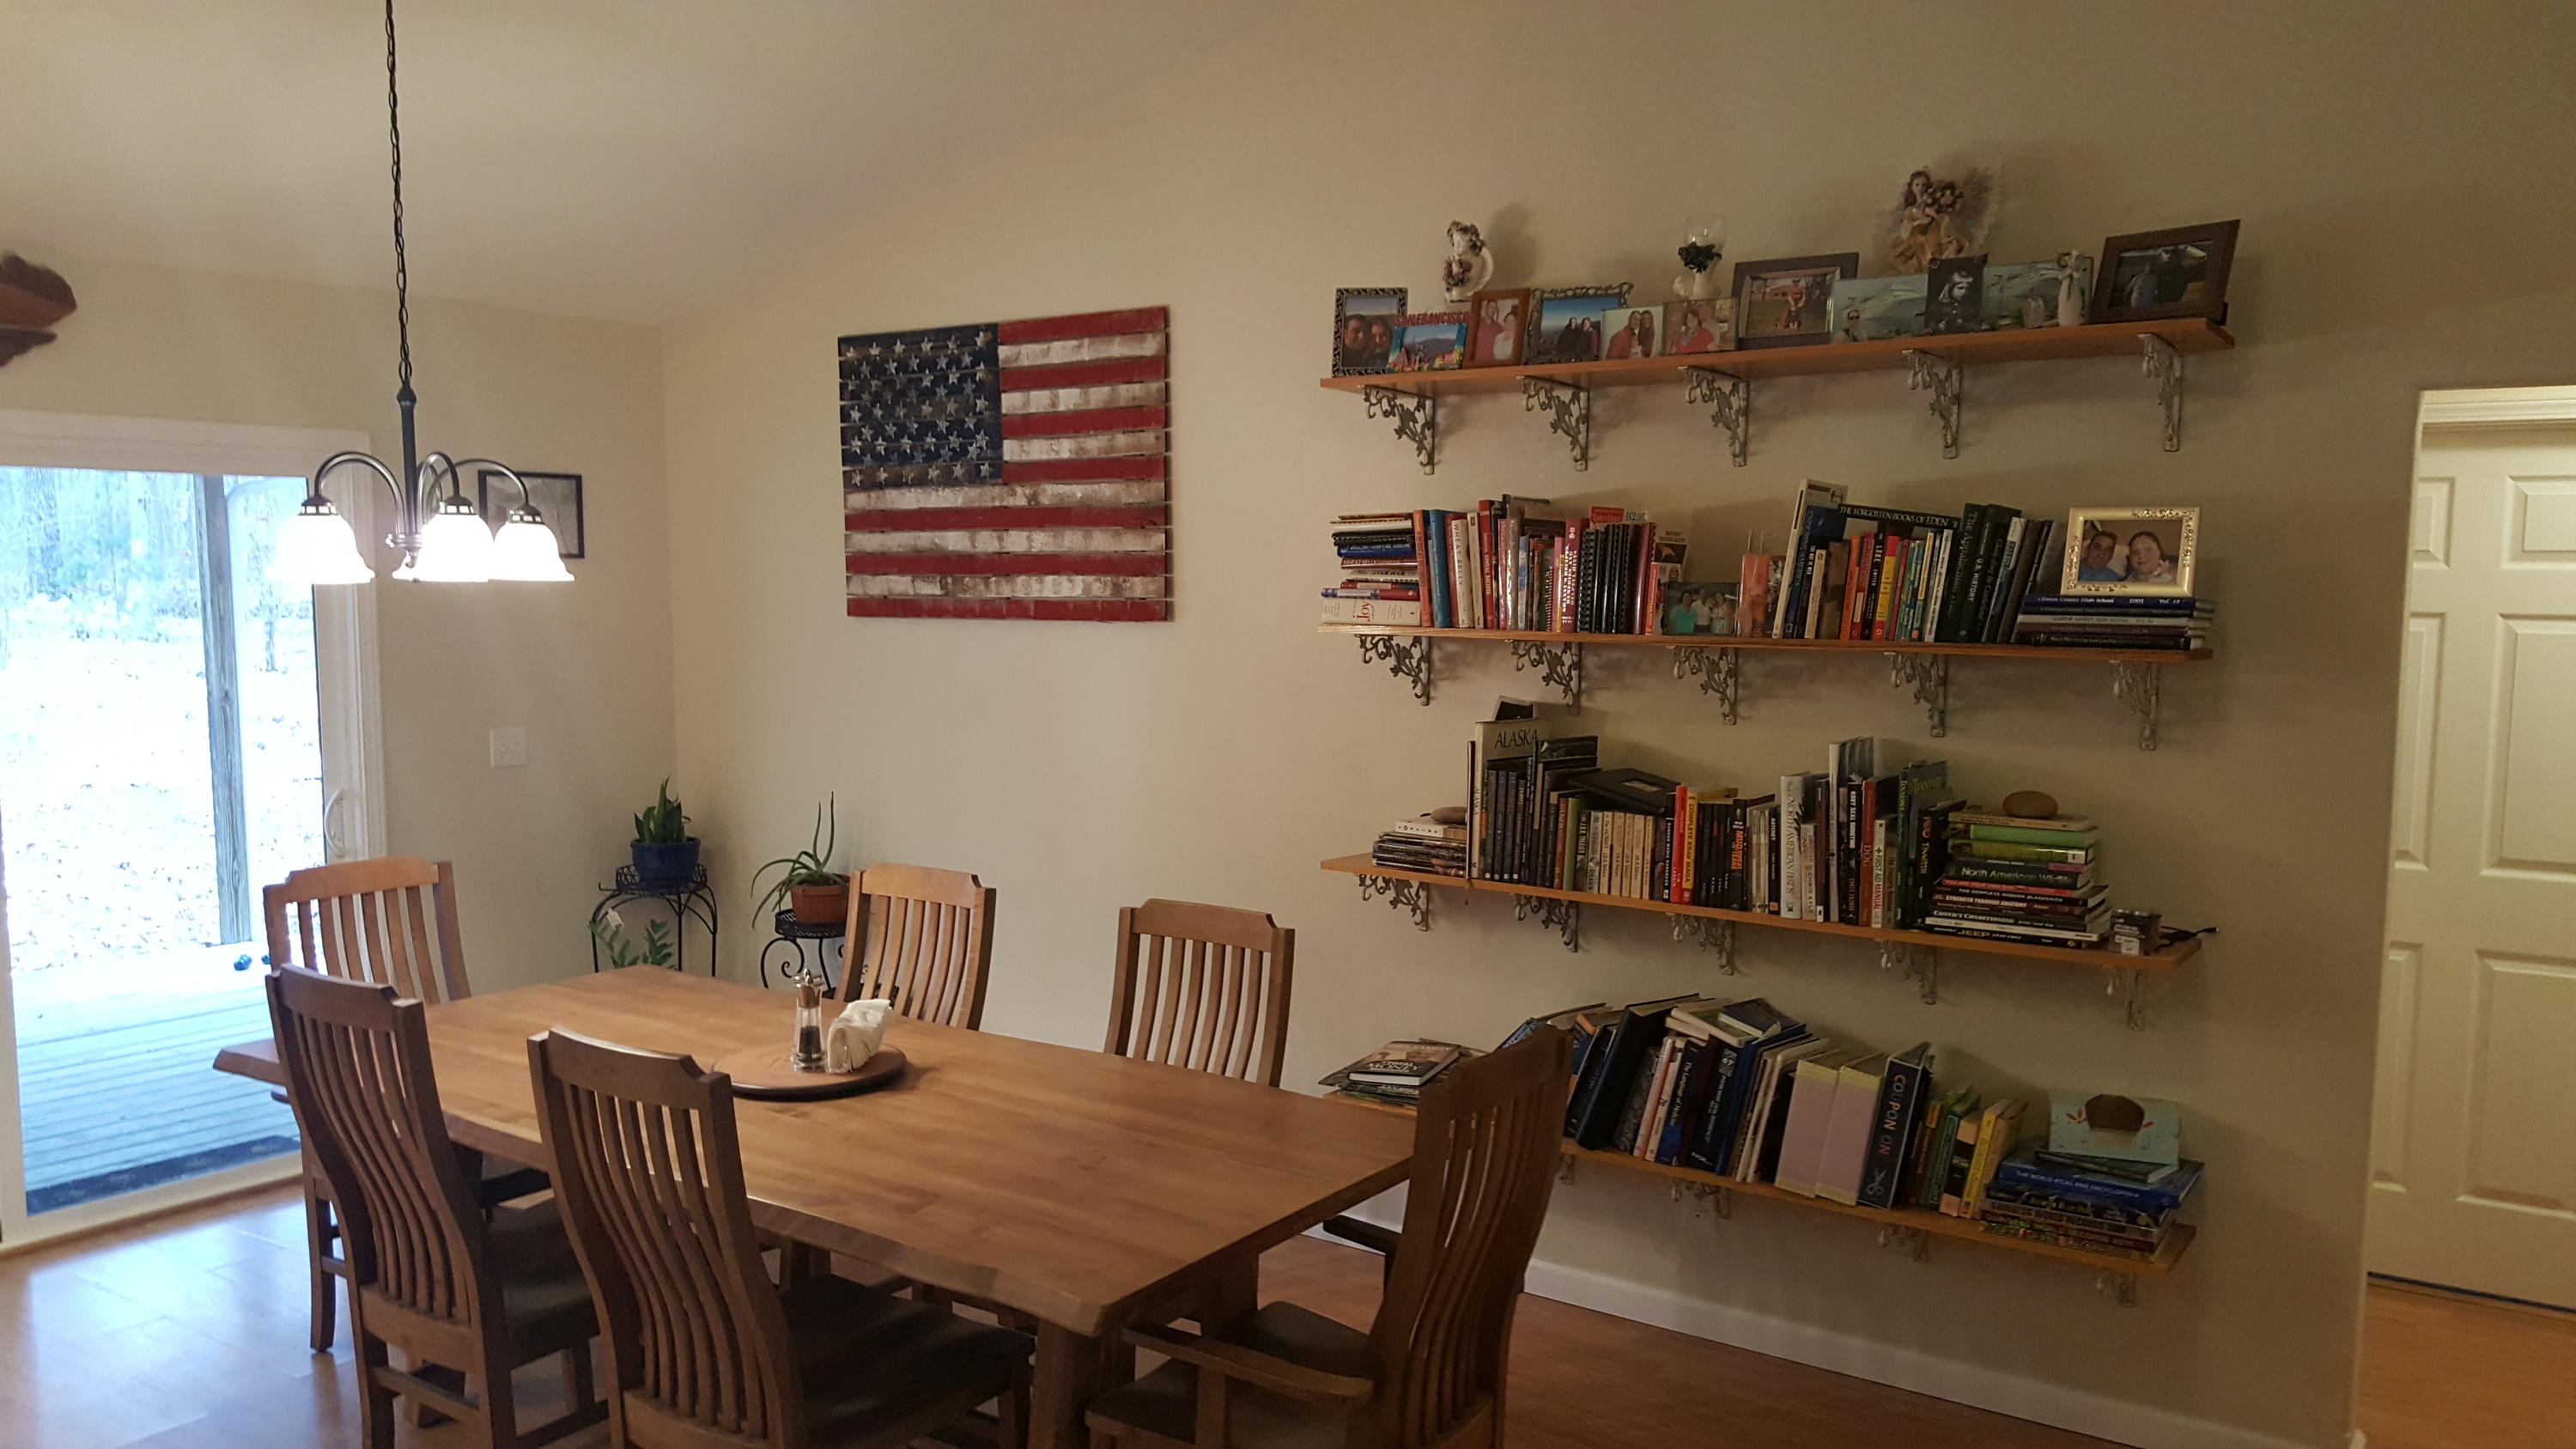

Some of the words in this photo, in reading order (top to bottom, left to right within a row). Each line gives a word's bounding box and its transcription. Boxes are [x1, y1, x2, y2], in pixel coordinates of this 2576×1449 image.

[1394, 314, 1415, 326] SAN
[1840, 506, 1854, 514] THE
[1854, 508, 1892, 520] FORGOTTEN
[1892, 511, 1917, 522] BOOKS
[1926, 516, 1948, 527] EDEN
[1965, 509, 1978, 531] The
[1950, 531, 1974, 594] Appalachian
[1966, 571, 1980, 602] HISTORY
[1493, 728, 1540, 750] ALASKA
[1686, 802, 1695, 839] COMPLETE
[1785, 796, 1795, 829] NORTH
[1784, 831, 1795, 871] AMERICAN
[1862, 843, 1872, 868] DOG
[1874, 854, 1882, 871] FIRST
[1961, 867, 1988, 878] North
[1990, 869, 2037, 880] American
[1785, 870, 1795, 894] BIRDS
[1873, 882, 1881, 910] MANUAL
[1945, 895, 1974, 904] STRENGTH
[1974, 897, 2001, 906] TRAINING
[2000, 899, 2027, 909] ANATOMY
[1971, 889, 2001, 898] COMPLETE
[1933, 910, 1963, 919] CONVICT
[1964, 913, 2015, 924] CONDITIONING
[1957, 929, 1990, 938] JEEP
[1881, 1074, 1908, 1132] COUPON
[1876, 1135, 1894, 1156] ON
